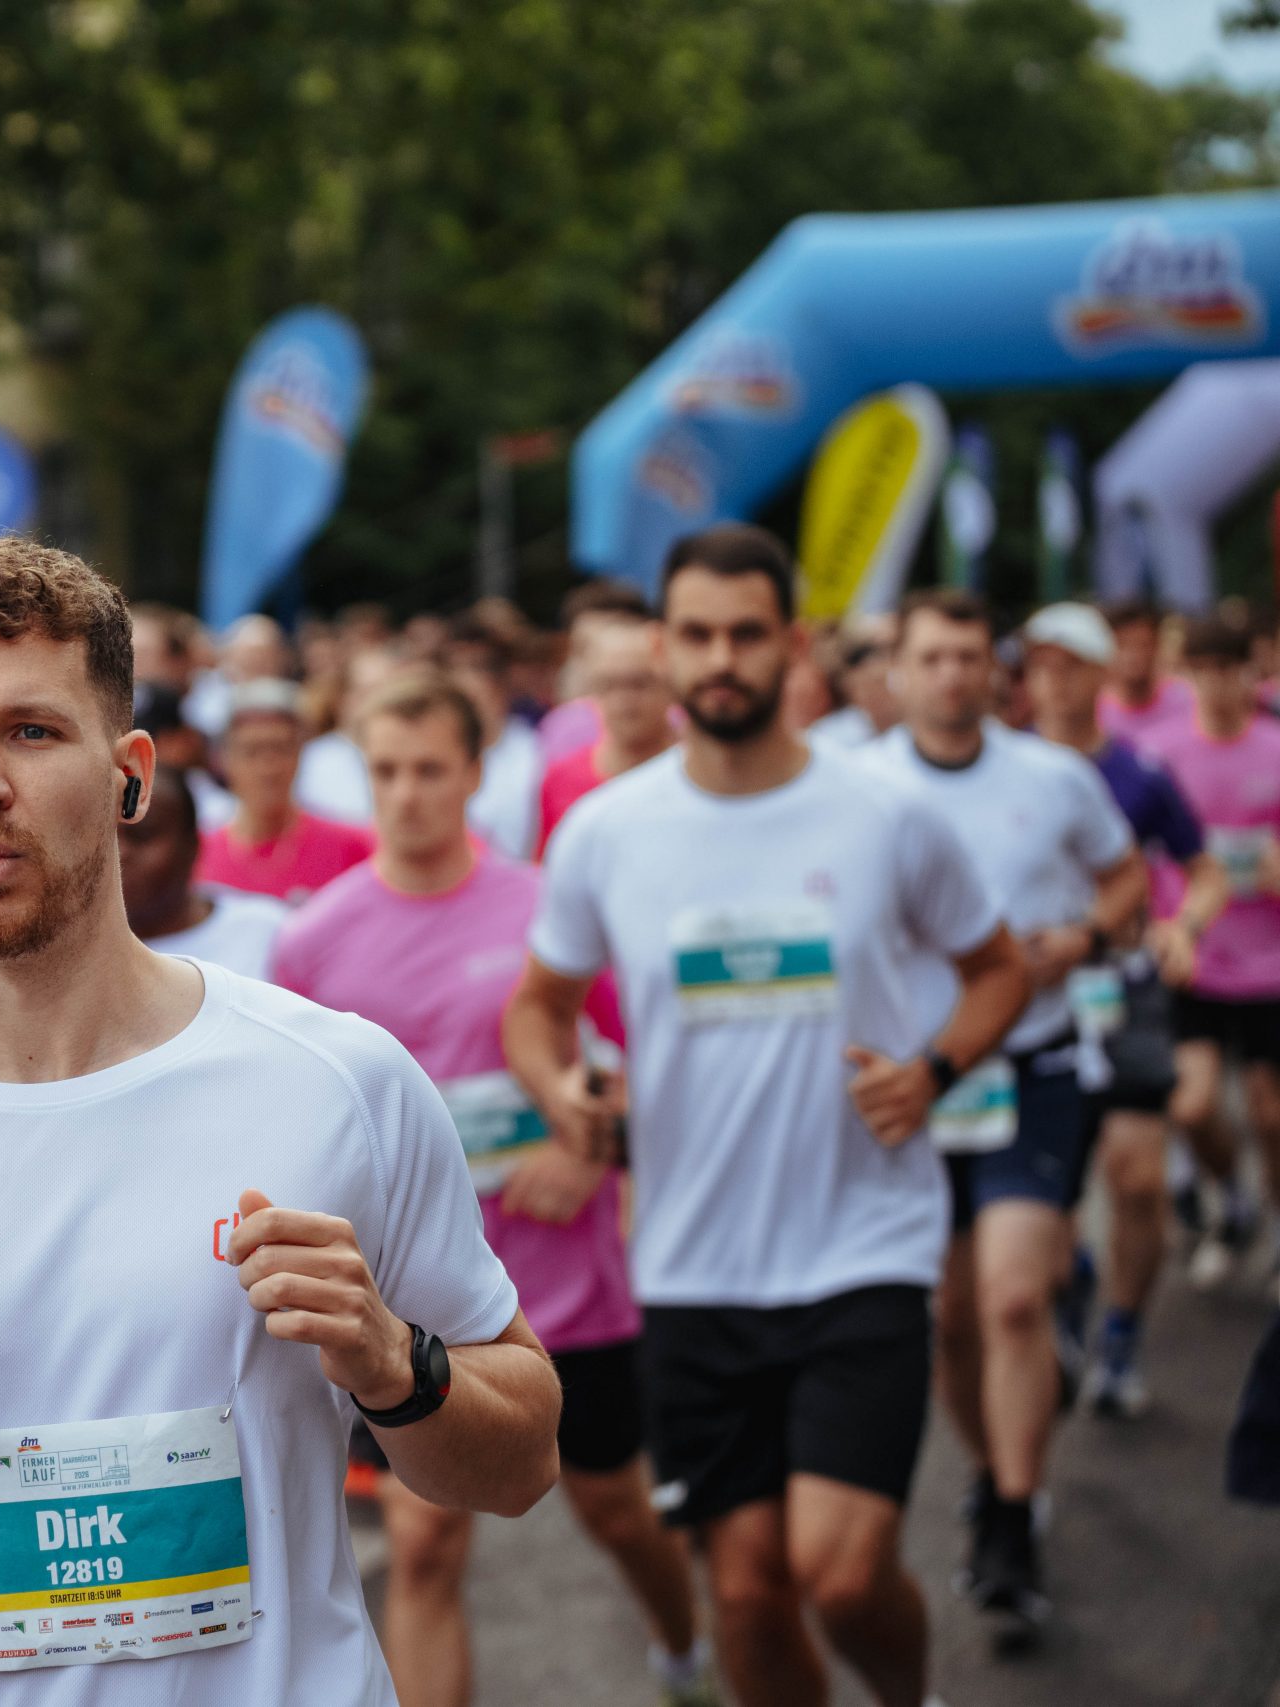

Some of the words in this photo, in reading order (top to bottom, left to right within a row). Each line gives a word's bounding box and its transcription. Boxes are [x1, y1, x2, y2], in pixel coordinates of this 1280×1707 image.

[21, 1436, 38, 1447] dm
[22, 1456, 55, 1468] FIRMEN
[62, 1454, 97, 1464] SAARBRÜCKEN
[23, 1468, 56, 1482] LAUF
[36, 1505, 128, 1551] Dirk
[46, 1556, 124, 1585] 12819
[50, 1592, 86, 1604] STARTZEIT
[88, 1590, 105, 1601] 18:15
[106, 1589, 122, 1599] UHR
[200, 1624, 226, 1635] FORUM
[152, 1631, 193, 1643] WOCHENSPIEGEL
[0, 1649, 37, 1658] BAUHAUS
